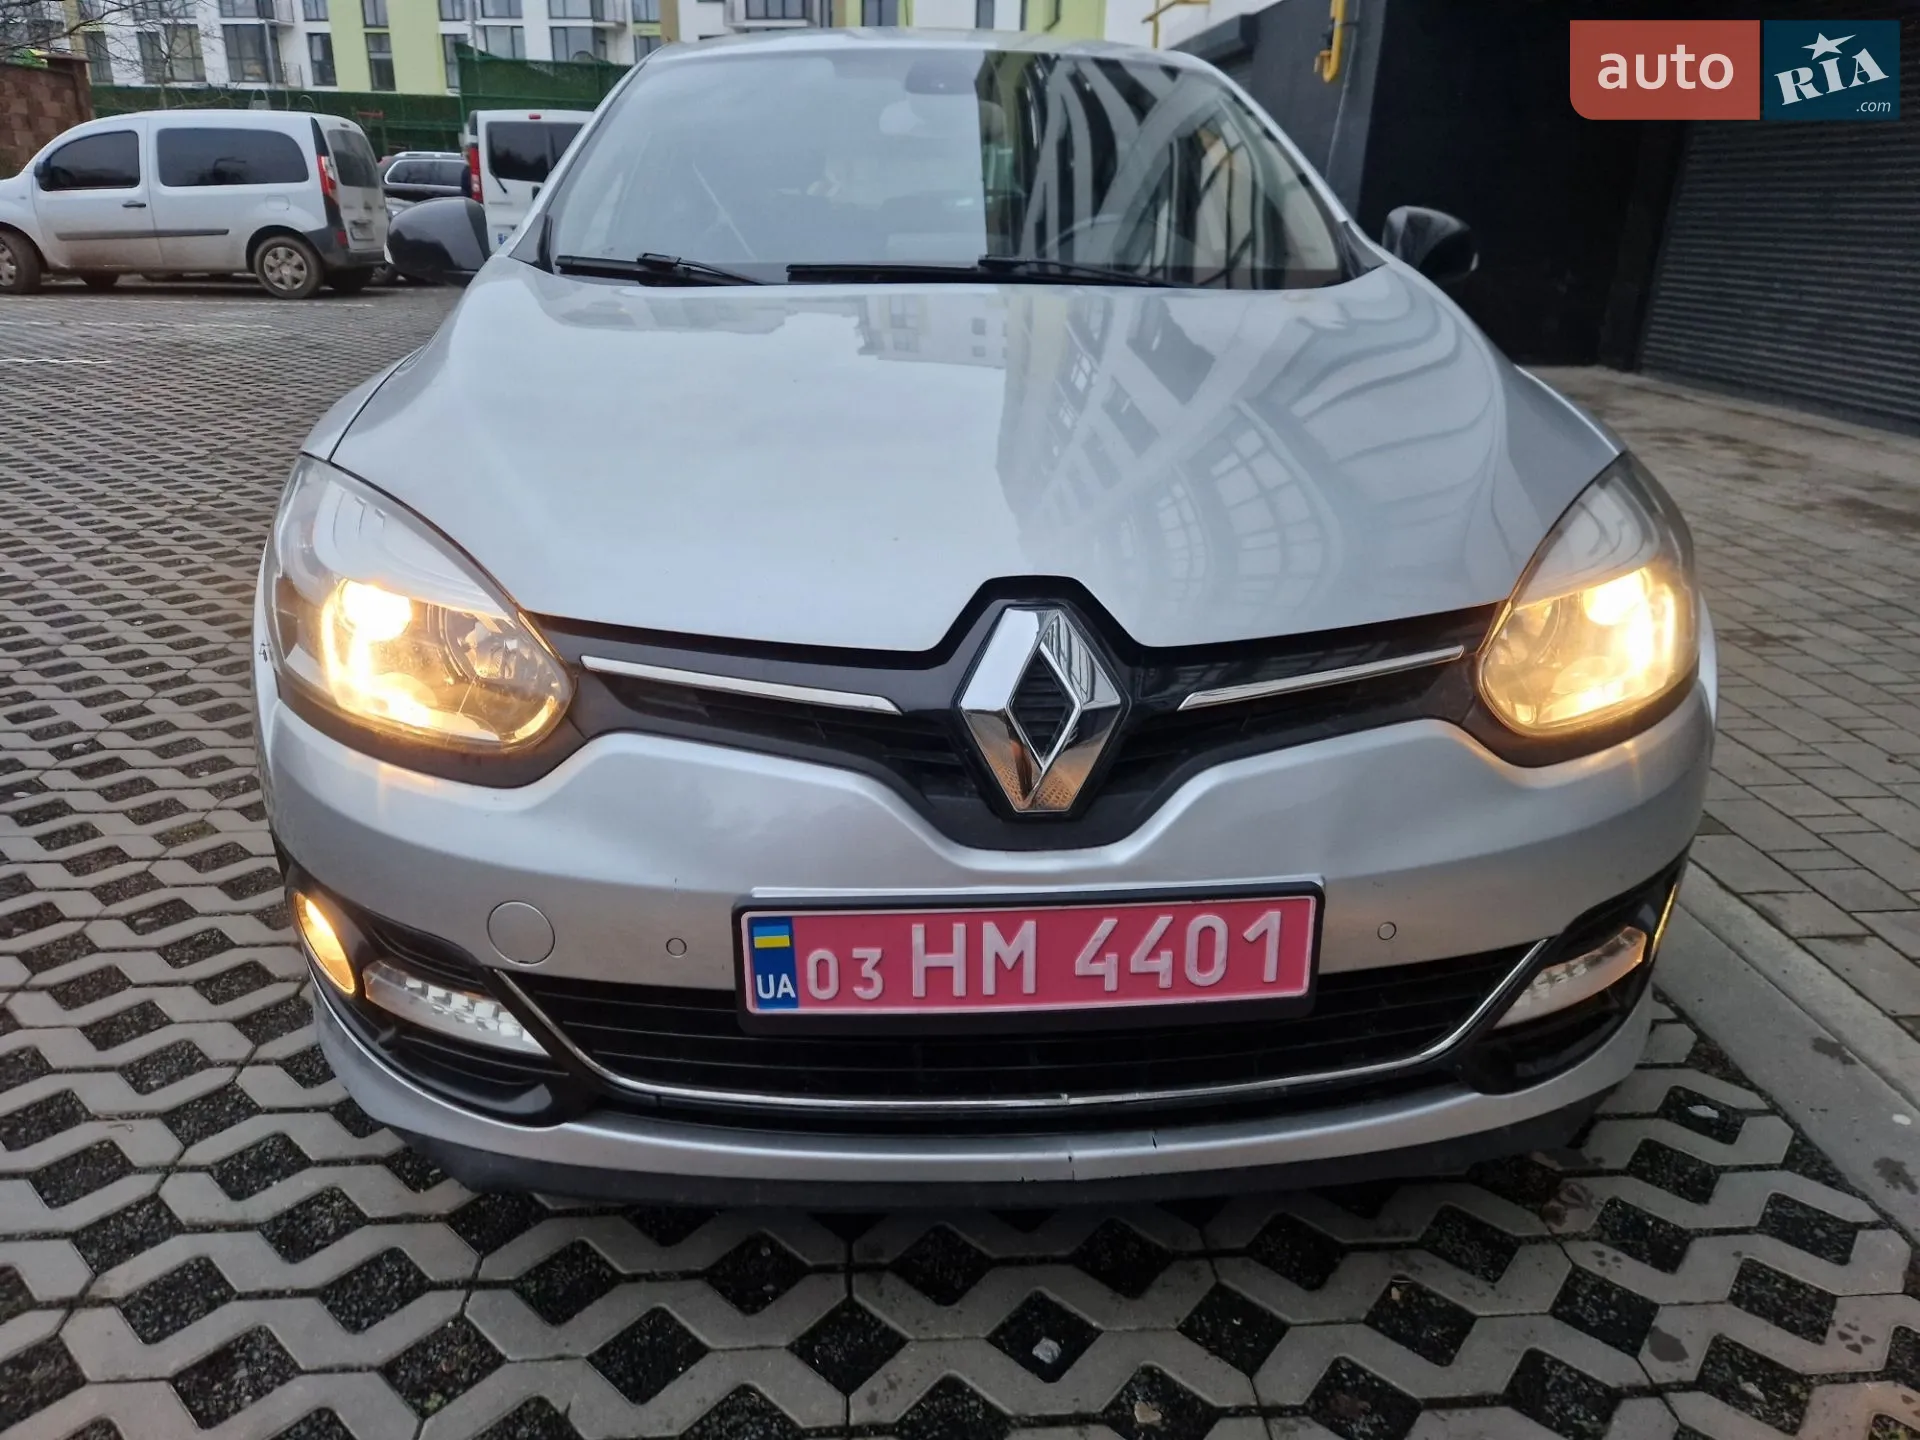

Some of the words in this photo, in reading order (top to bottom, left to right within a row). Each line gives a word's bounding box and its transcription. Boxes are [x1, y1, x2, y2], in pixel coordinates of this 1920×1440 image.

[806, 948, 885, 1001] 03
[911, 920, 1037, 999] HM
[1074, 910, 1283, 992] 4401
[756, 973, 797, 1000] UA
